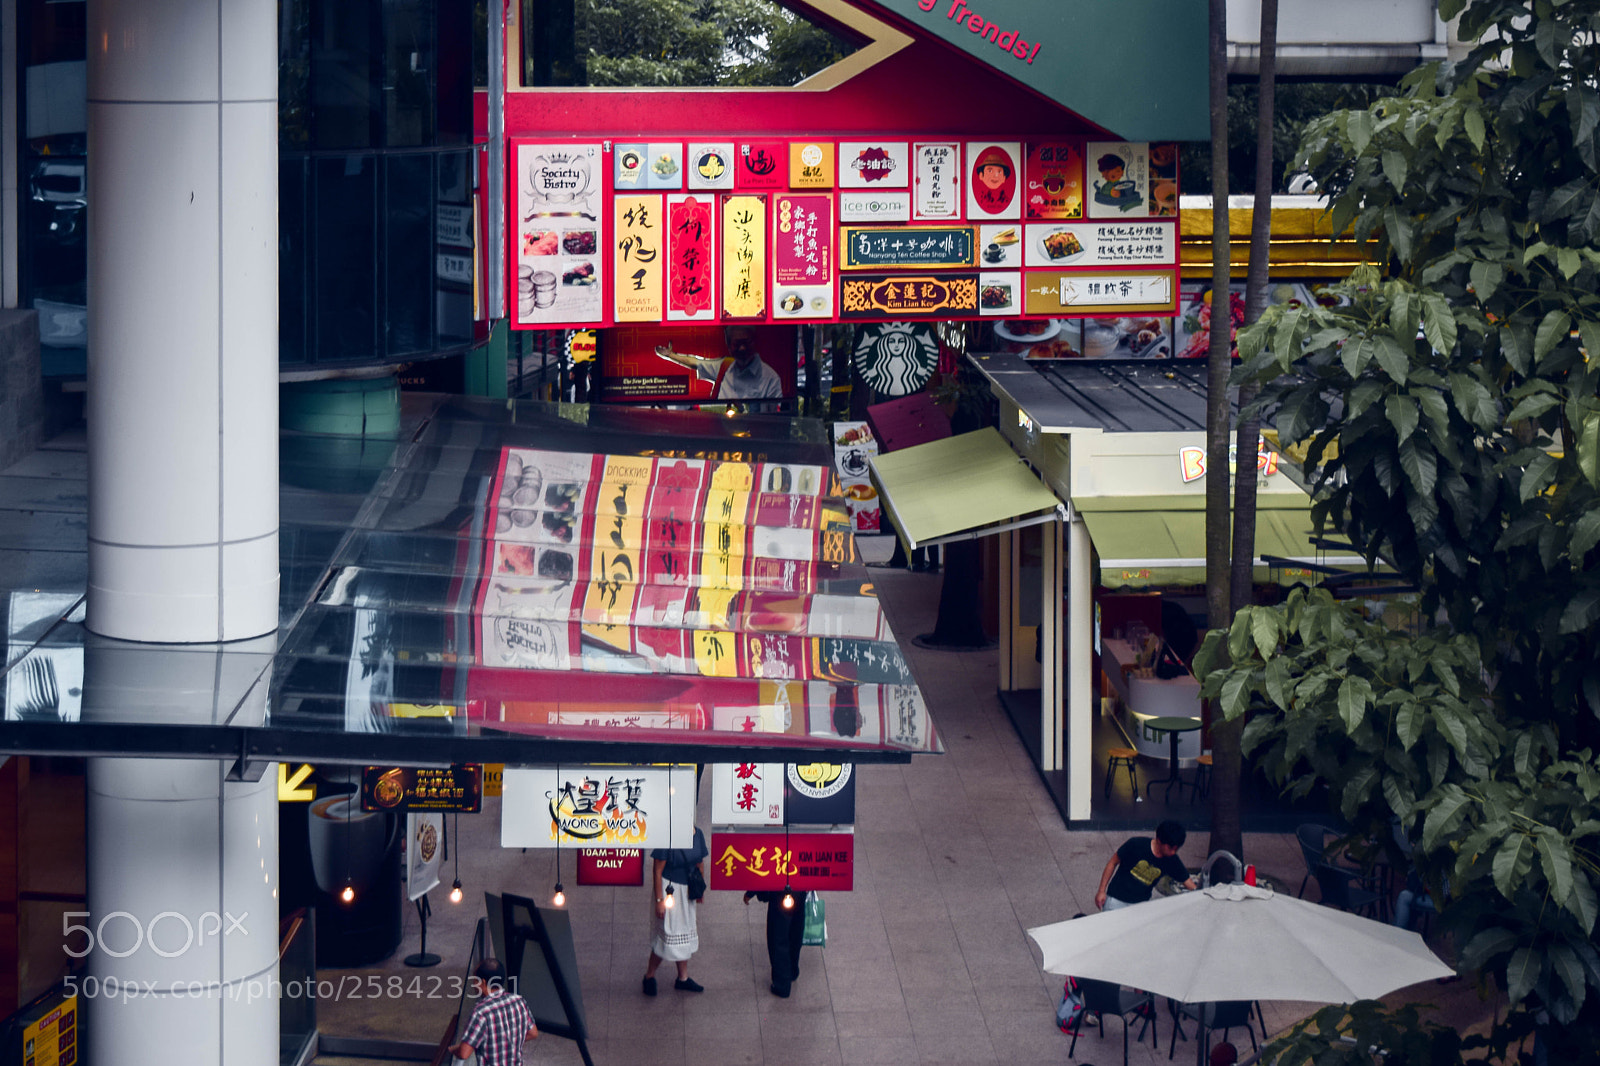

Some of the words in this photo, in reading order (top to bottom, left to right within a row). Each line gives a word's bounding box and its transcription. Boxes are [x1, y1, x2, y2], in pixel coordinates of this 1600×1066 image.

[947, 0, 1041, 64] Trends!
[542, 167, 580, 181] Society
[544, 179, 576, 188] Bistro
[844, 199, 862, 212] ice
[866, 201, 902, 212] room
[558, 818, 599, 829] WONG
[606, 818, 636, 829] WOK
[799, 852, 812, 862] KIM
[835, 851, 847, 862] KEE
[596, 860, 623, 868] DAILY
